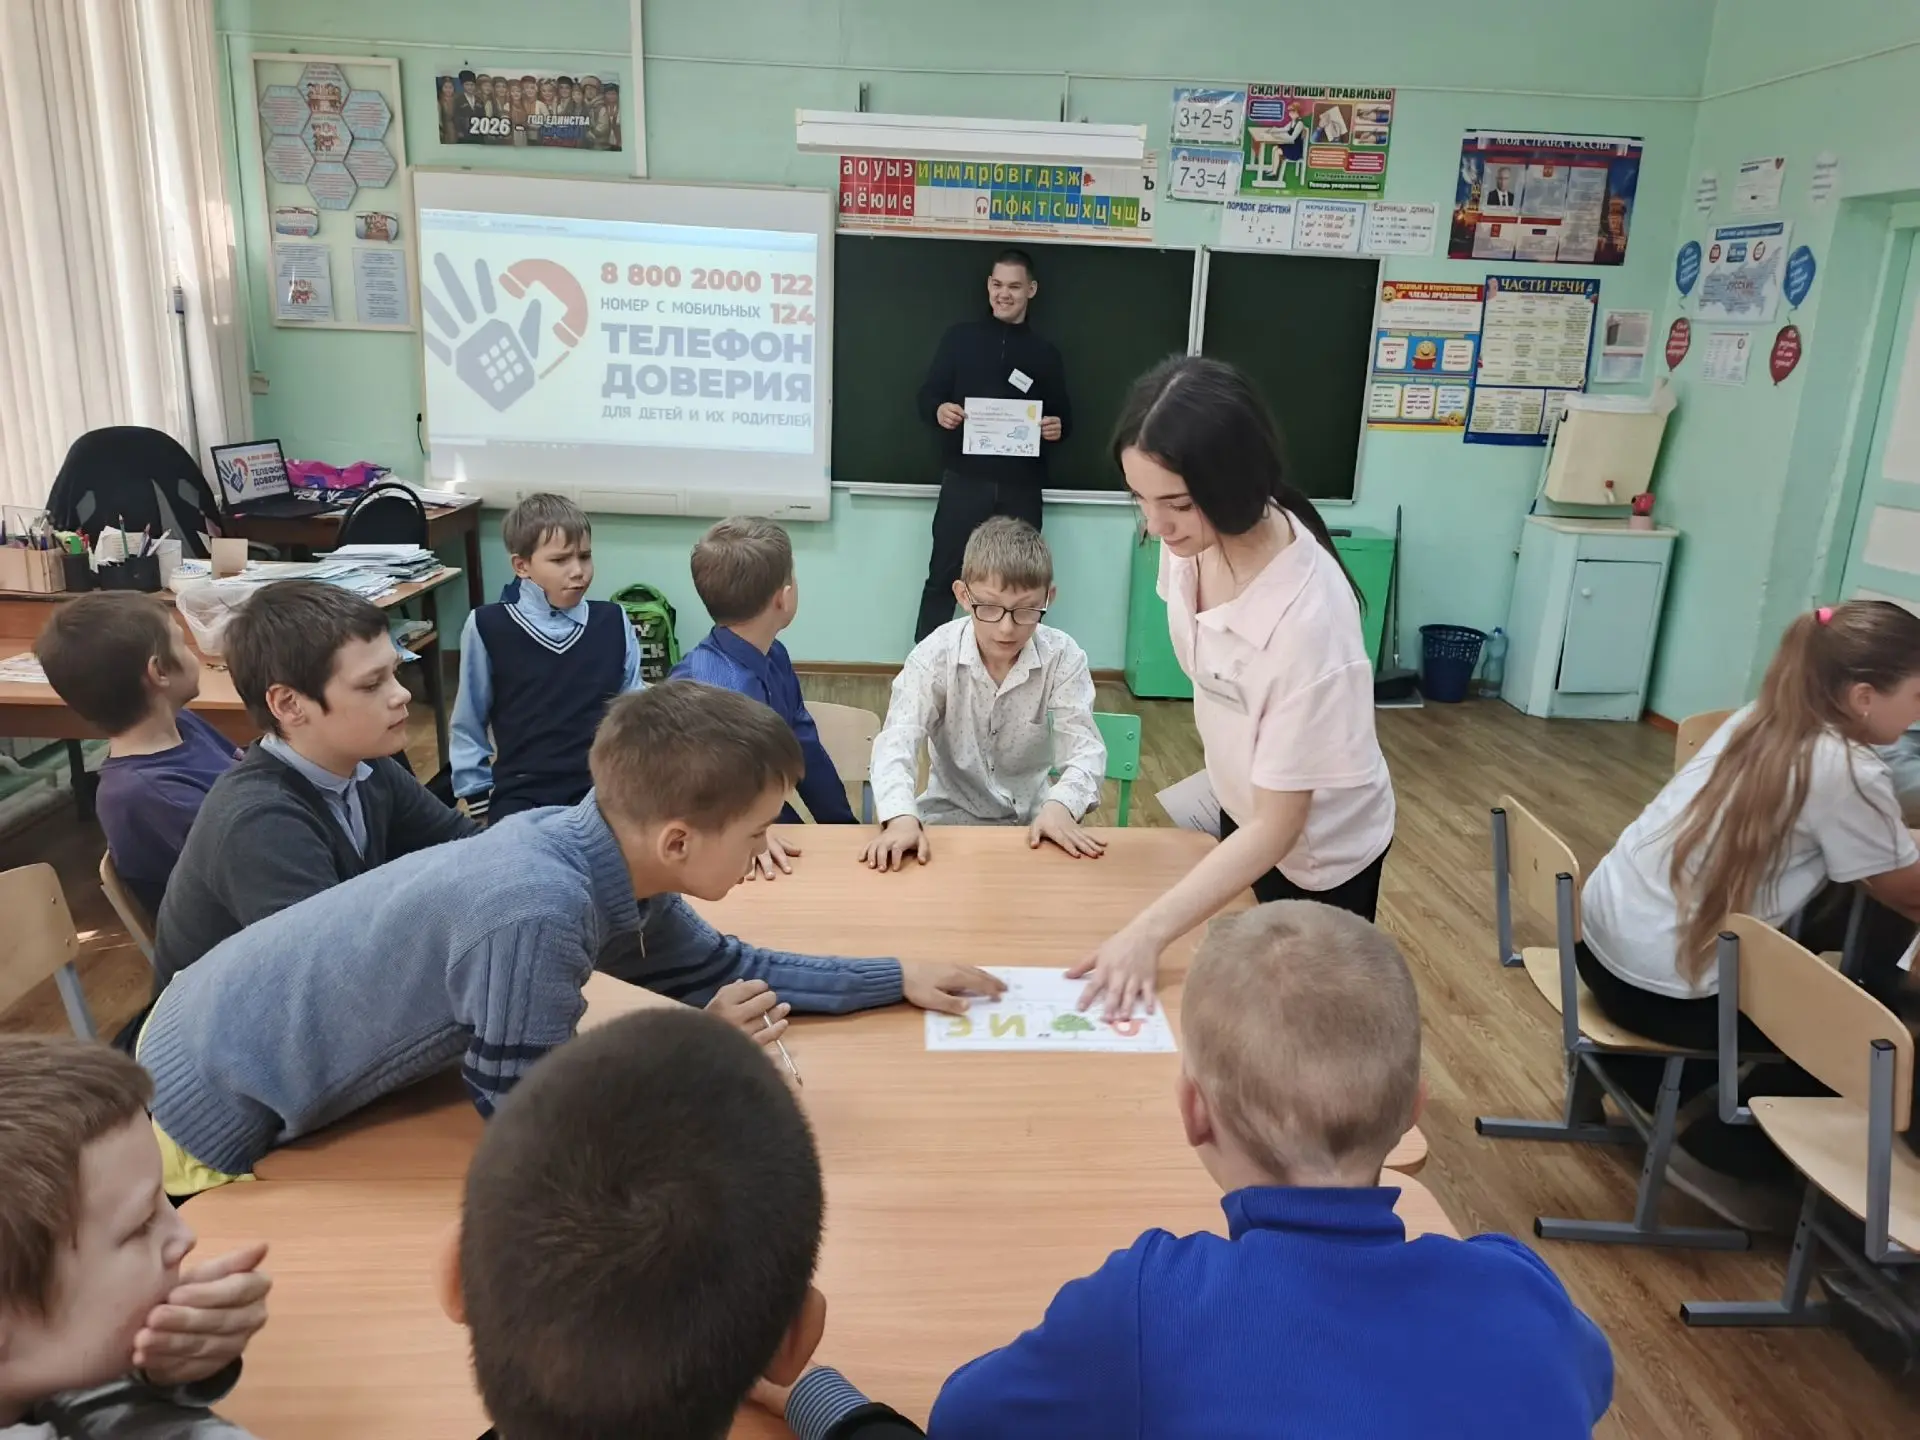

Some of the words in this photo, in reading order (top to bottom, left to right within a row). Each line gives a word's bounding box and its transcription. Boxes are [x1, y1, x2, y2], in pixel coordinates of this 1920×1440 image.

[1250, 85, 1280, 96] СИДИ
[1284, 87, 1291, 96] И
[1294, 87, 1326, 97] ПИШИ
[1328, 88, 1393, 100] ПРАВИЛЬНО
[470, 116, 511, 135] 2026
[527, 115, 544, 126] ГОД
[546, 115, 590, 126] ЕДИНСТВА
[1180, 107, 1233, 130] 3+2=5
[843, 160, 853, 175] а
[858, 160, 868, 176] о
[874, 160, 884, 182] у
[886, 161, 900, 177] ы
[903, 162, 913, 177] э
[933, 165, 944, 179] н
[947, 165, 960, 179] м
[964, 165, 974, 180] л
[979, 166, 989, 187] р
[993, 163, 1004, 183] б
[1008, 167, 1018, 183] в
[1024, 168, 1033, 184] г
[1037, 169, 1050, 189] д
[1054, 170, 1064, 185] з
[1067, 170, 1081, 186] ж
[1180, 166, 1227, 190] 7-3=4
[843, 192, 852, 207] я
[858, 187, 867, 208] ё
[870, 193, 884, 208] ю
[887, 194, 897, 209] и
[903, 194, 912, 210] е
[992, 199, 1002, 214] п
[1006, 194, 1018, 220] ф
[1022, 201, 1031, 215] к
[1038, 201, 1047, 216] т
[1053, 202, 1062, 217] с
[1065, 203, 1079, 218] ш
[1081, 204, 1091, 219] х
[1095, 204, 1107, 224] ц
[1111, 205, 1121, 221] ч
[1124, 205, 1137, 224] щ
[1226, 201, 1256, 212] ПОРЯДОК
[1257, 203, 1291, 214] ДЕЙСТВИЙ
[600, 262, 618, 284] 8
[627, 263, 682, 288] 800
[690, 268, 762, 293] 2000
[770, 272, 814, 296] 122
[1501, 278, 1547, 292] ЧАСТИ
[1550, 280, 1585, 293] РЕЧИ
[600, 297, 649, 312] НОМЕР
[656, 300, 665, 313] С
[672, 302, 761, 318] МОБИЛЬНЫХ
[770, 303, 815, 326] 124
[600, 322, 813, 364] ТЕЛЕФОН
[601, 362, 812, 403] ДОВЕРИЯ
[601, 404, 632, 419] ДЛЯ
[638, 405, 683, 421] ДЕТЕЙ
[689, 411, 699, 421] И
[706, 411, 724, 422] ИХ
[732, 411, 812, 428] РОДИТЕЛЕЙ
[254, 474, 287, 486] ДОВЕРИЯ
